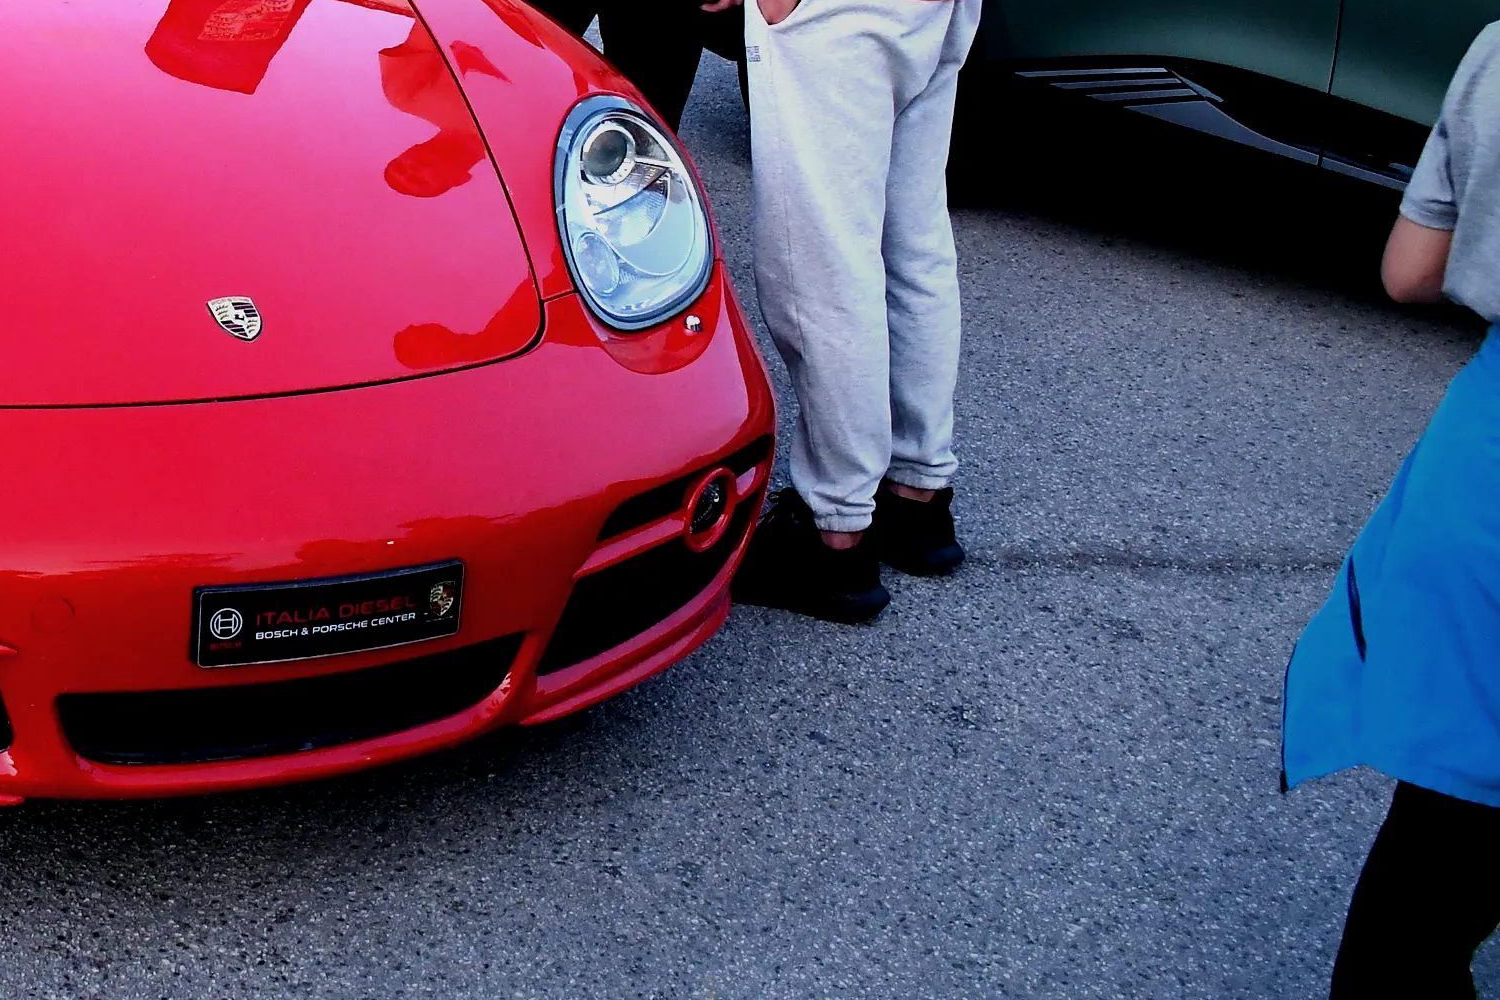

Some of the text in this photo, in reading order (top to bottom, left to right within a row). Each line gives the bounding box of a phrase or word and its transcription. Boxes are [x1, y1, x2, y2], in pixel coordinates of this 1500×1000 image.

[256, 596, 417, 626] ITALIA DIESEL
[255, 628, 298, 640] BOSCH
[301, 627, 309, 636] &
[312, 620, 368, 635] PORSCHE
[371, 612, 416, 627] CENTER
